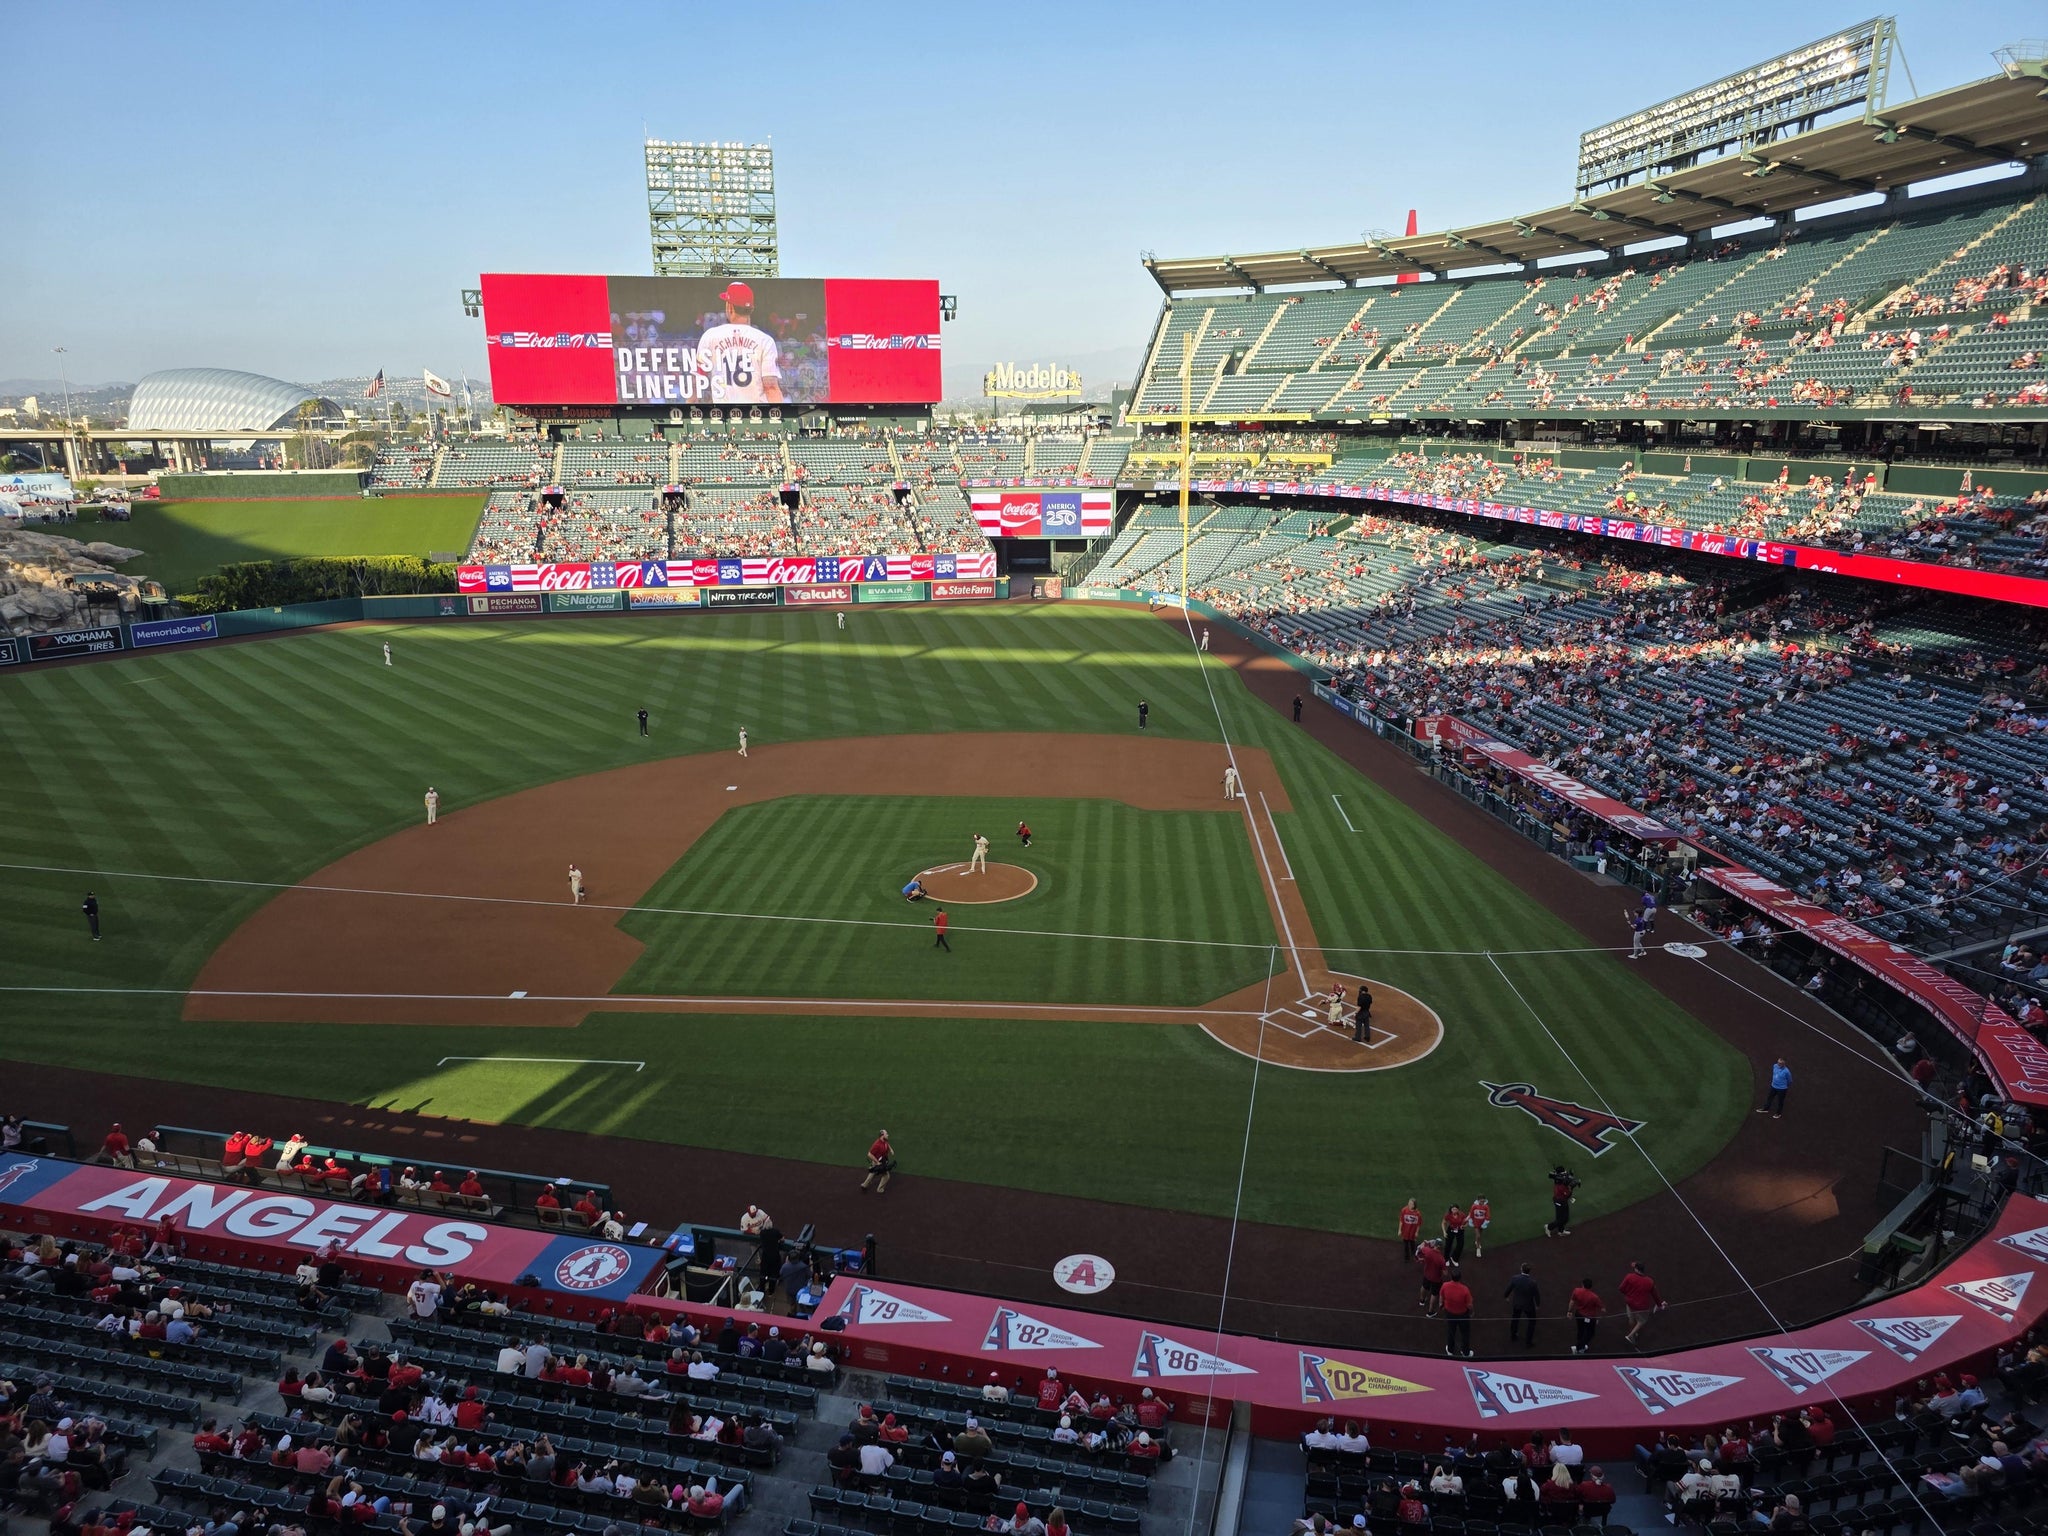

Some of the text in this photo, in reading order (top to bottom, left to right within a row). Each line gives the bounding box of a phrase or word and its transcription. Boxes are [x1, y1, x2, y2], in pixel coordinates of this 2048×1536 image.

[618, 348, 756, 373] DEFENSIVE
[995, 361, 1069, 389] Modelo
[621, 374, 726, 400] LINEUPS
[21, 483, 53, 492] LIGHT
[1002, 502, 1041, 516] Coca-Cola
[1046, 509, 1077, 526] 250
[721, 569, 740, 580] 250
[936, 564, 955, 574] 250
[489, 575, 509, 586] 250
[570, 593, 616, 605] National
[633, 592, 675, 605] Surfside
[711, 591, 775, 602] NITTO TIRE.COM
[790, 586, 849, 600] Yakult
[490, 598, 537, 606] PECHANGA
[136, 618, 201, 640] MemorialCare
[54, 629, 113, 645] YOKOHAMA
[88, 641, 115, 651] TIRES
[1518, 764, 1607, 800] 2026
[1477, 1079, 1649, 1159] A
[77, 1176, 489, 1267] ANGELS
[584, 1245, 627, 1262] ANGELS
[559, 1268, 613, 1289] BASEBALL
[1066, 1259, 1097, 1287] A
[1820, 1351, 1842, 1360] DIVISION
[1824, 1355, 1856, 1365] CHAMPIONS
[1199, 1363, 1232, 1373] CHAMPIONS
[1201, 1358, 1225, 1367] DIVISION
[1367, 1376, 1392, 1385] WORLD
[1689, 1375, 1712, 1385] DIVISION
[1692, 1380, 1724, 1390] CHAMPIONS
[1368, 1382, 1408, 1392] CHAMPIONS
[1538, 1393, 1574, 1401] CHAMPIONS
[1719, 1488, 1738, 1500] 27
